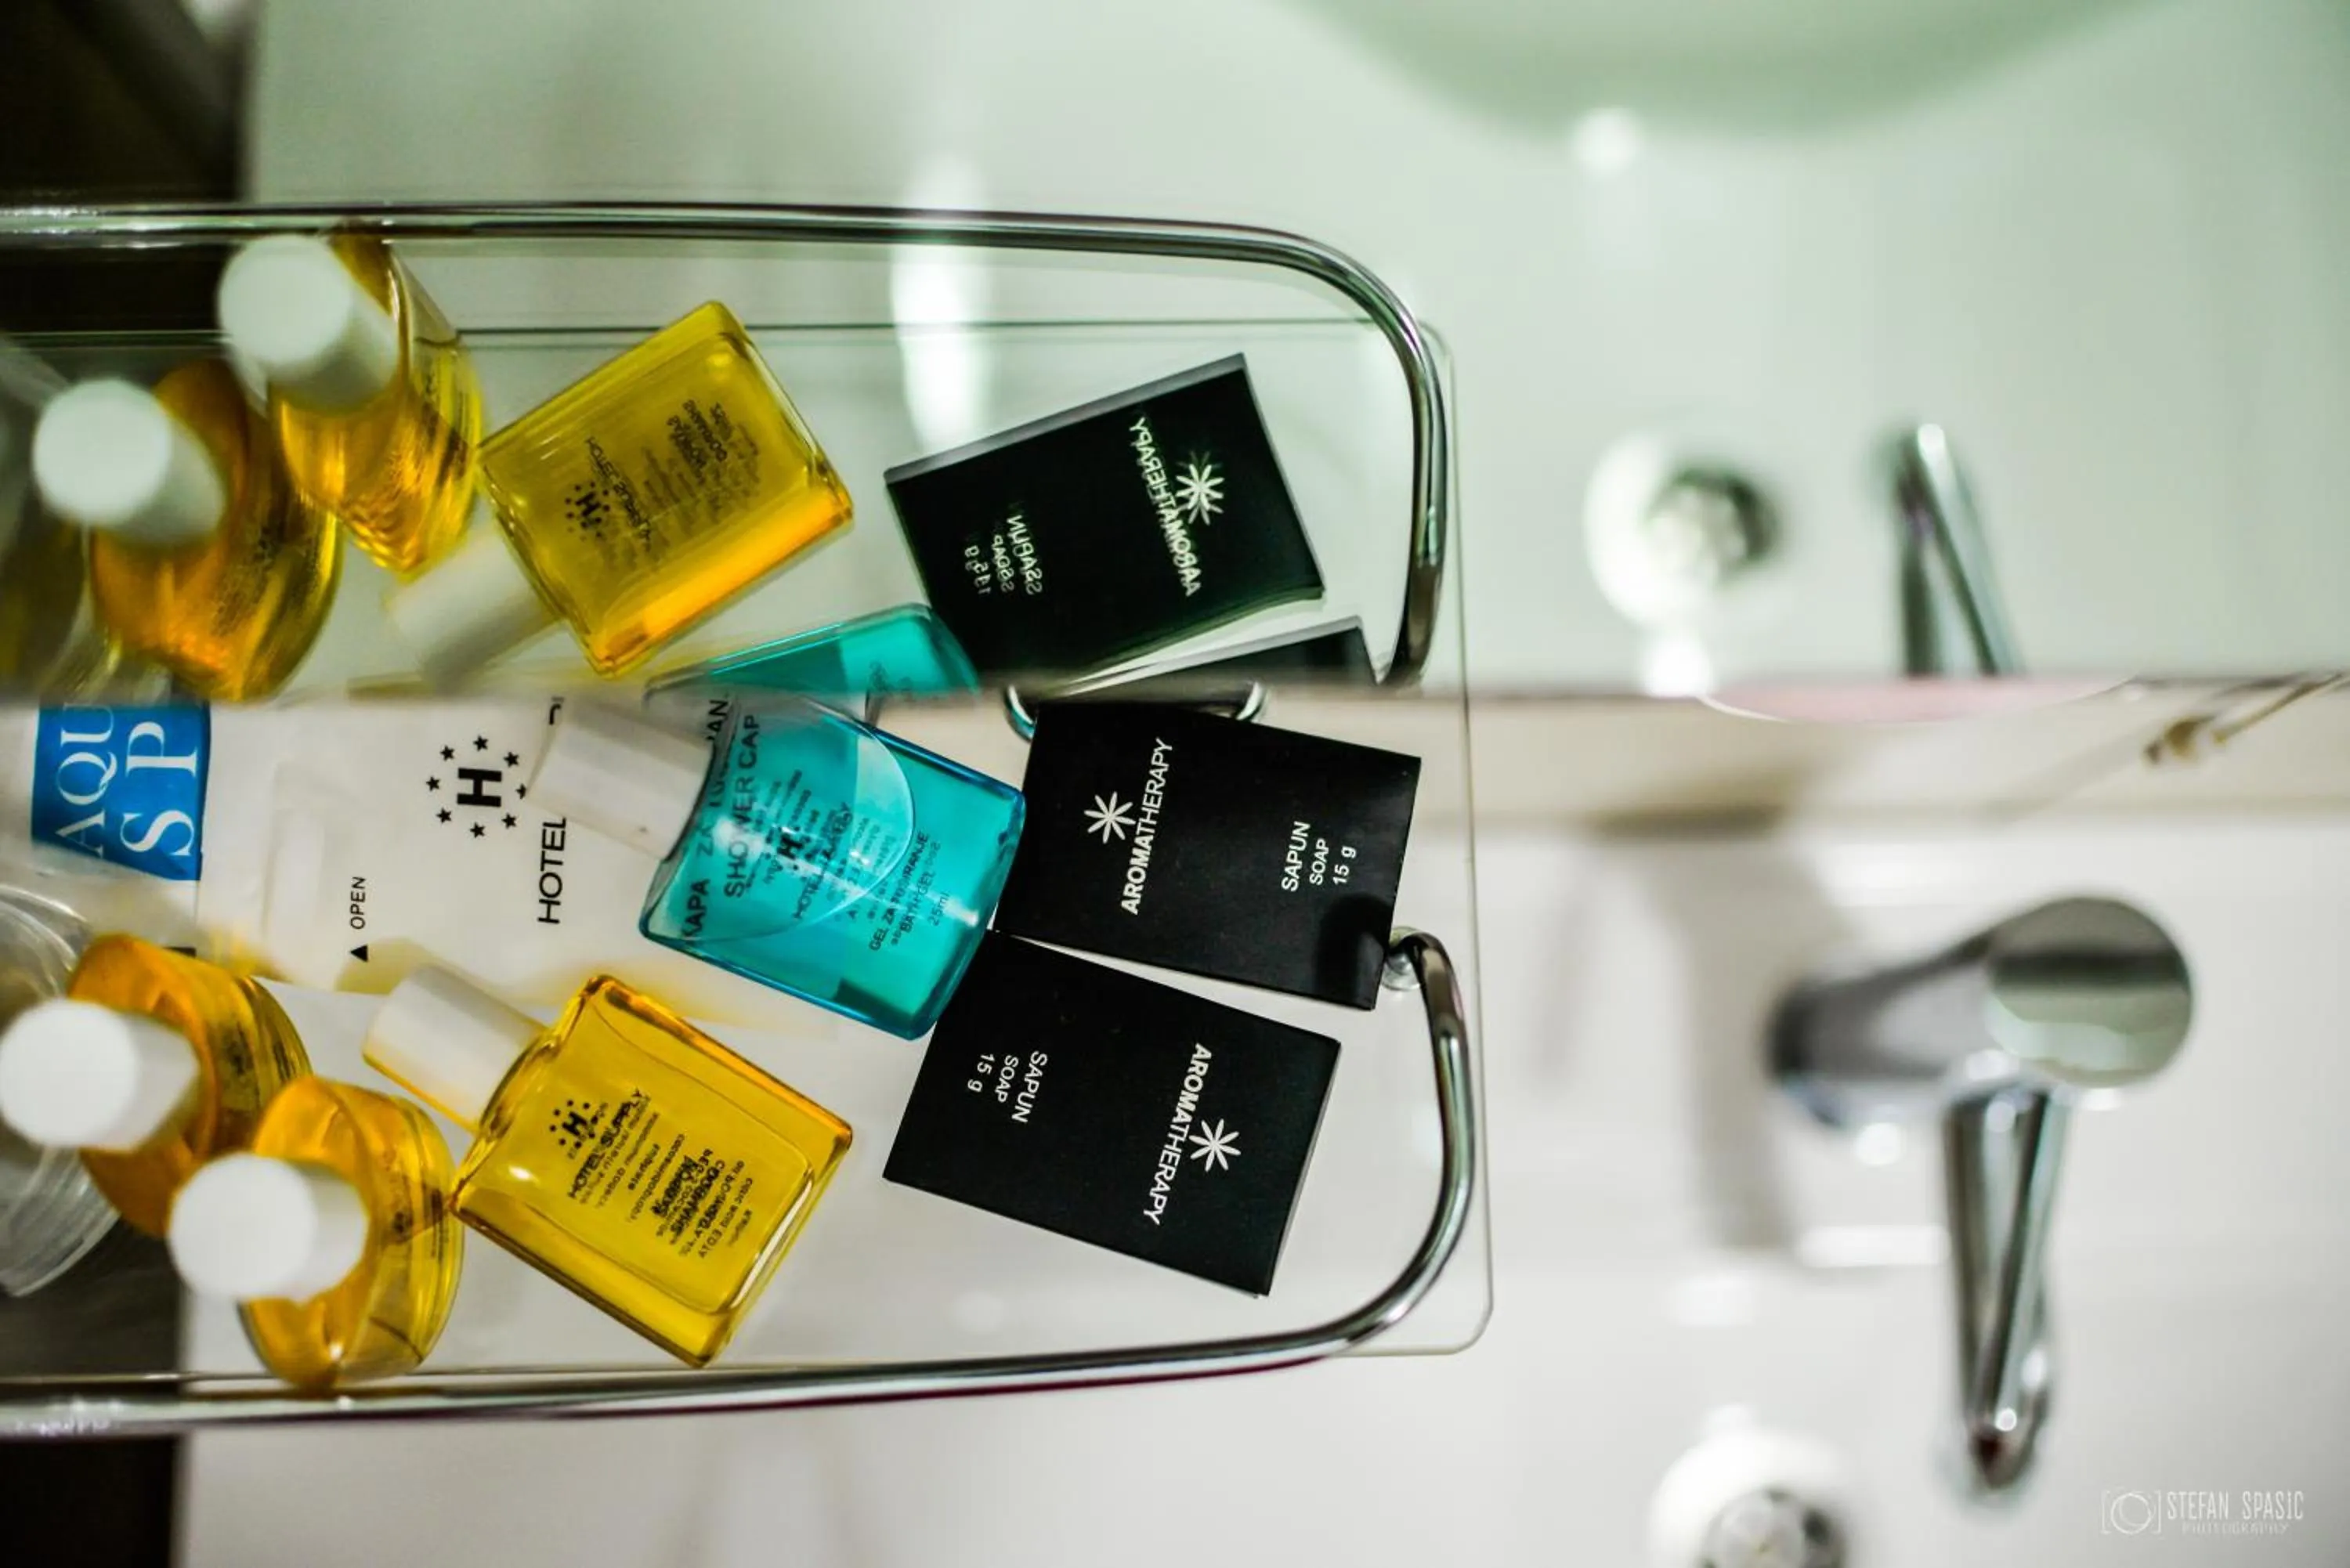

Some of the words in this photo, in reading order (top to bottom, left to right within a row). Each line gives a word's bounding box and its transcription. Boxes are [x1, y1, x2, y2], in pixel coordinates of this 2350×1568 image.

[739, 714, 761, 771] CAP
[1121, 738, 1173, 915] AROMATHERAPY
[537, 818, 566, 924] HOTEL
[1281, 821, 1311, 892] SAPUN
[1309, 838, 1330, 886] SOAP
[1332, 862, 1349, 886] 15
[1342, 845, 1357, 859] g
[351, 876, 366, 930] OPEN
[967, 1079, 984, 1093] g
[975, 1053, 992, 1075] 15
[995, 1054, 1019, 1104] SOAP
[1011, 1050, 1048, 1122] SAPUN
[568, 1152, 602, 1198] HOTEL
[601, 1089, 642, 1148] SUPPLY
[1143, 1042, 1213, 1225] AROMATHERAPY
